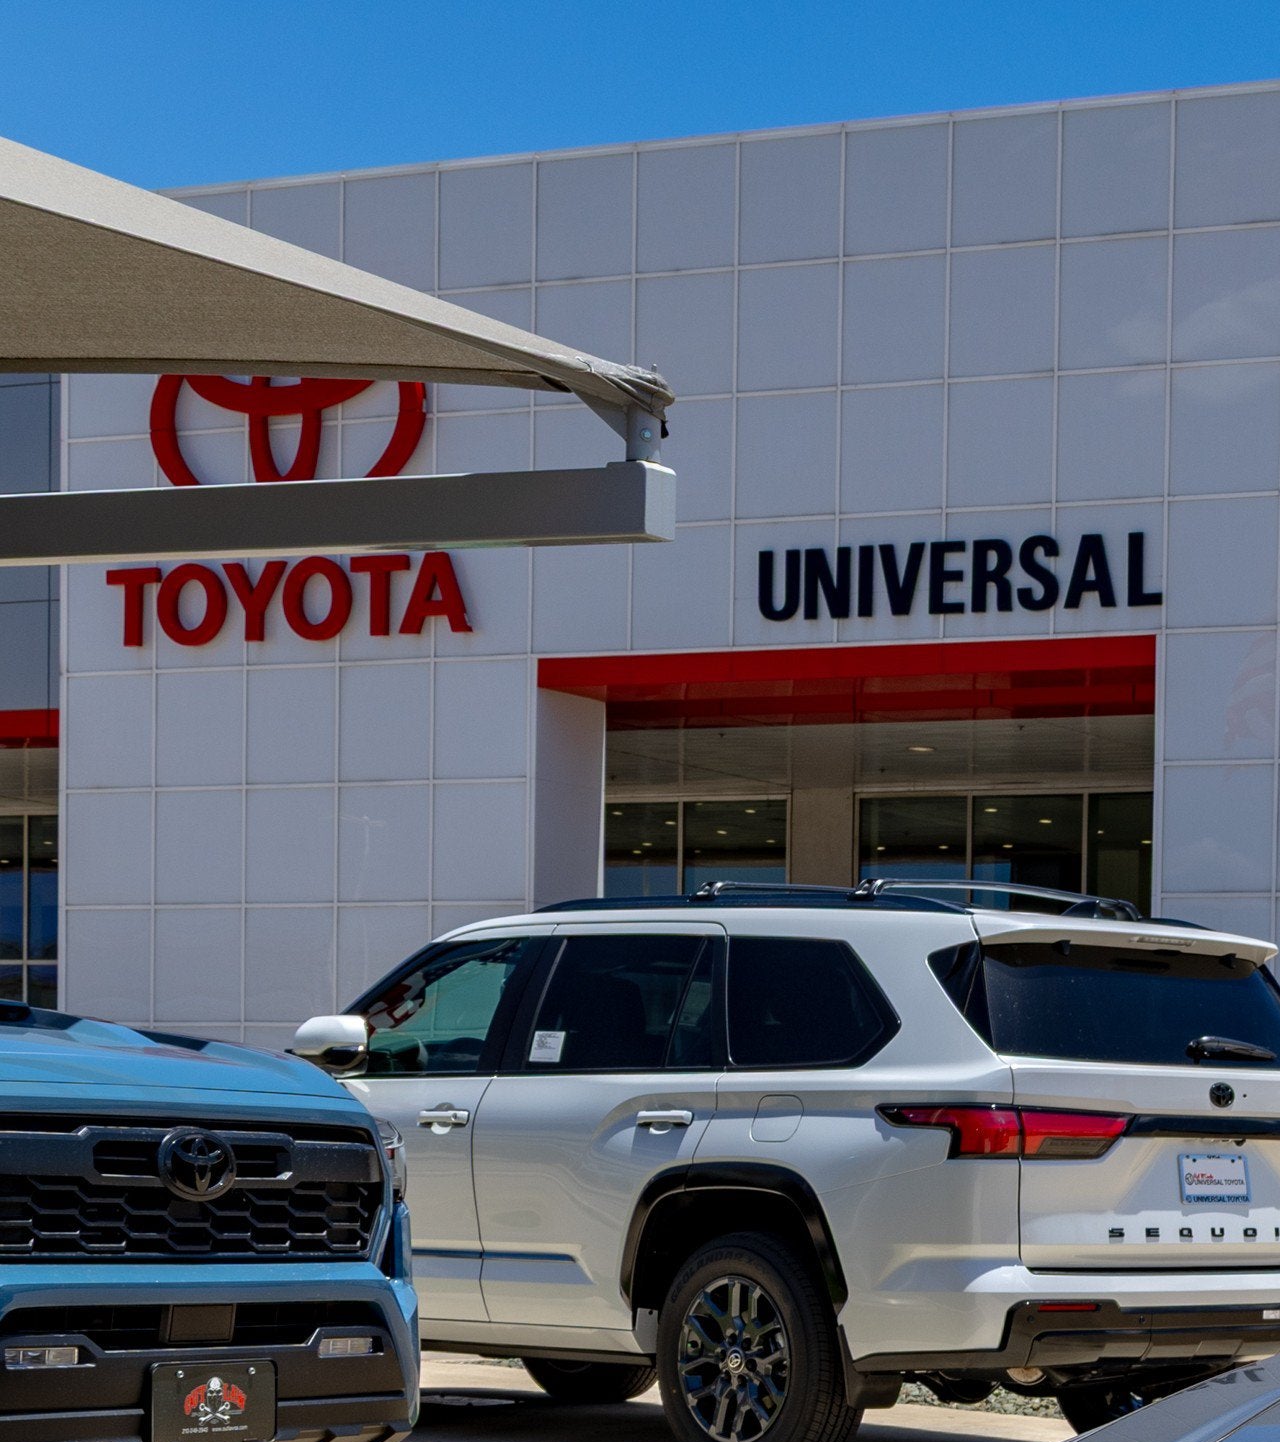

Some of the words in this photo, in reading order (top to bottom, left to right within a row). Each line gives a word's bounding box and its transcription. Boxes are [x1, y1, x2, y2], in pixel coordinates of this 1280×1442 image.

[106, 551, 473, 647] TOYOTA
[758, 531, 1163, 621] UNIVERSAL
[1193, 1194, 1226, 1203] UNIVERSAL
[1226, 1195, 1250, 1203] TOYOTA
[1194, 1178, 1224, 1186] UNIVERSAL
[1225, 1178, 1245, 1186] TOYOTA
